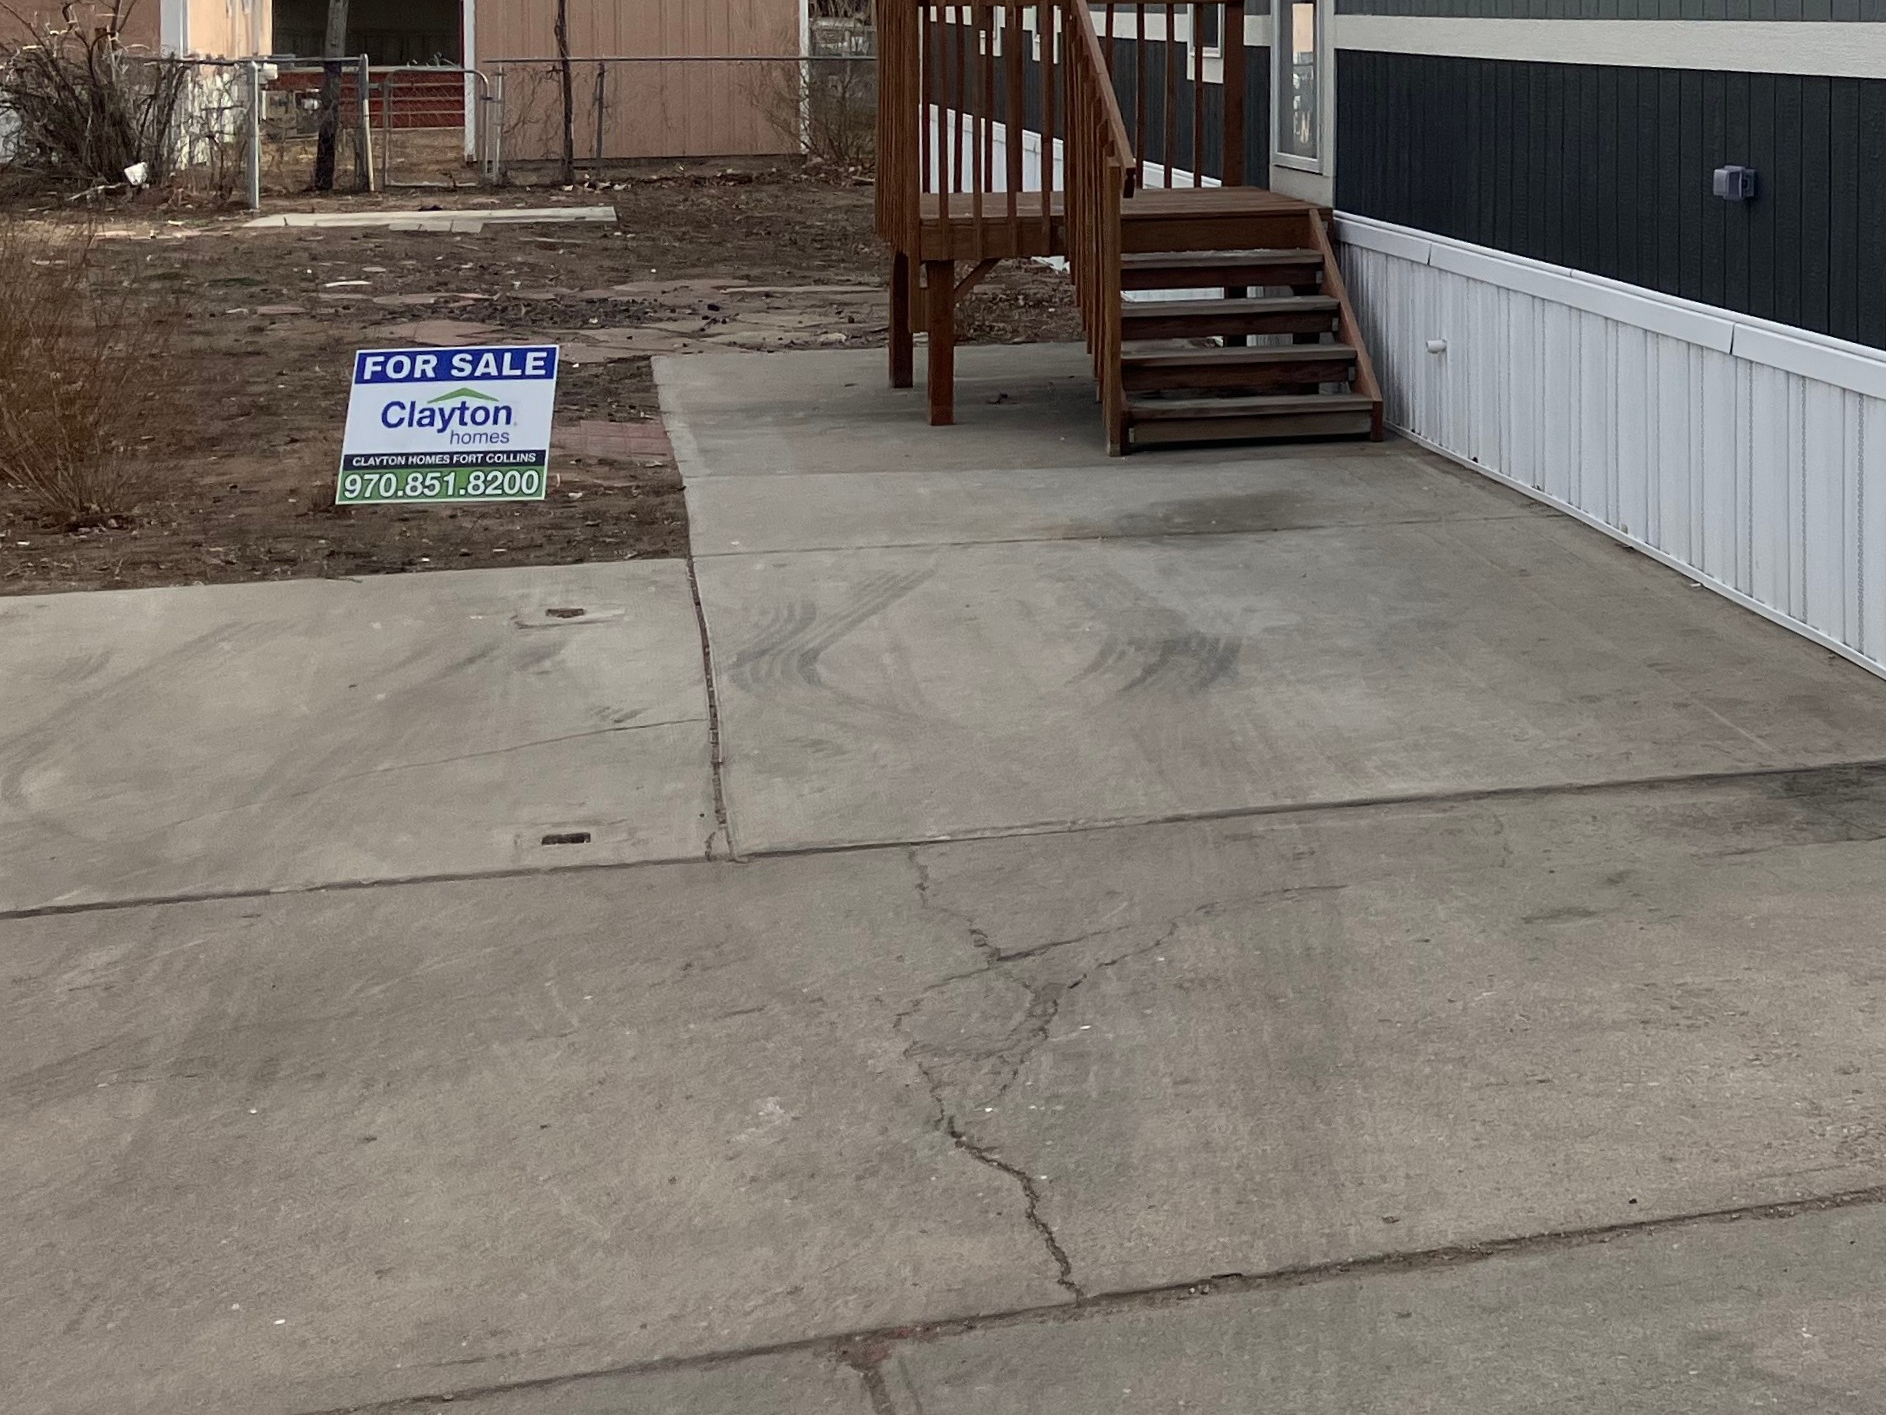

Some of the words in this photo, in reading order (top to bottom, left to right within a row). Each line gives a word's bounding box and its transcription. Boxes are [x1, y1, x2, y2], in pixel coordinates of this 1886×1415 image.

[363, 354, 438, 380] FOR
[450, 351, 548, 378] SALE
[381, 400, 513, 434] Clayton
[449, 430, 510, 445] homes
[352, 455, 406, 467] CLAYTON
[407, 454, 450, 465] HOMES
[452, 453, 483, 464] FORT
[486, 452, 536, 464] COLLINS
[344, 470, 540, 499] 970.851.8200
